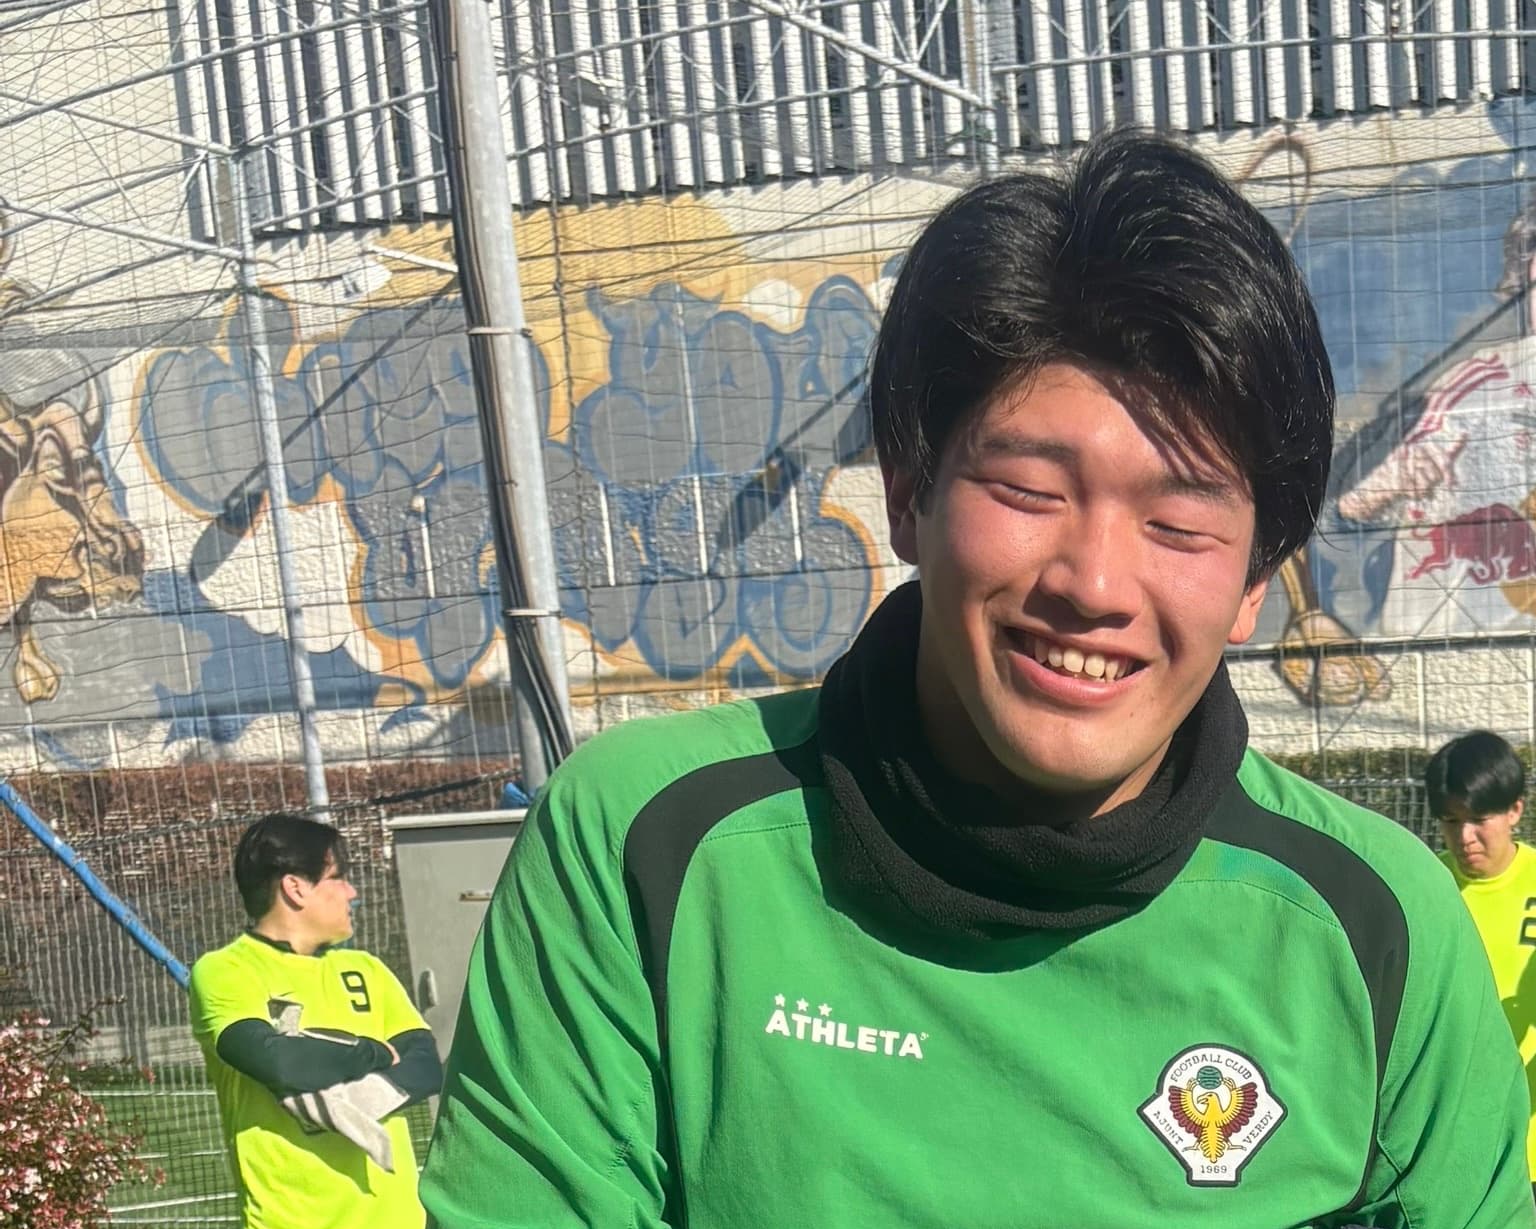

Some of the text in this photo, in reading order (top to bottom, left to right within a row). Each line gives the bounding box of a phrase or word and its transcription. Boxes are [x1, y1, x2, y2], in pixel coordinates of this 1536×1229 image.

[341, 970, 370, 1013] 9
[765, 1008, 923, 1059] ATHLETA
[1170, 1053, 1252, 1082] FOOTBALL CLUB
[1242, 1111, 1274, 1145] VERDY
[1200, 1165, 1227, 1174] 1969
